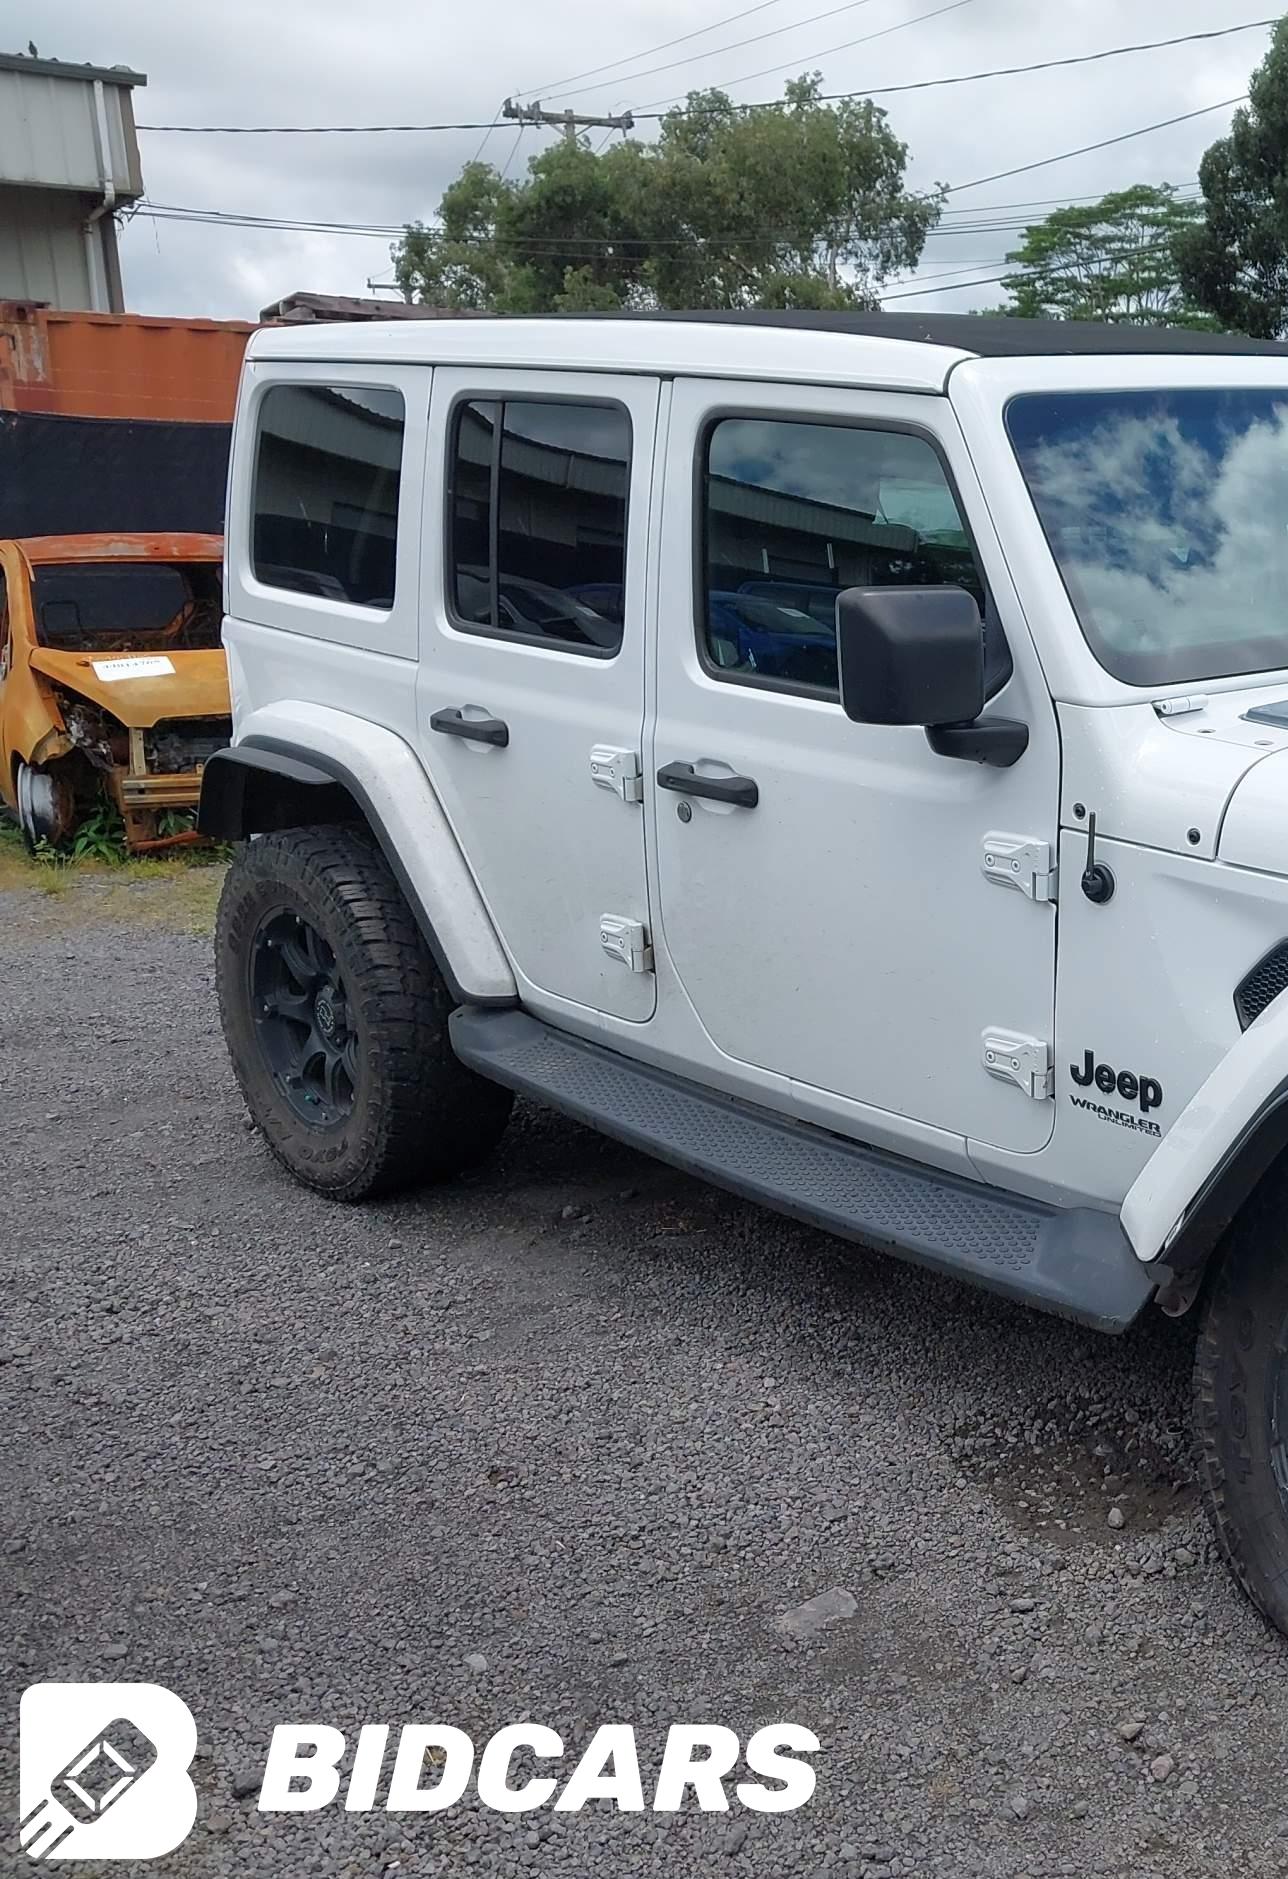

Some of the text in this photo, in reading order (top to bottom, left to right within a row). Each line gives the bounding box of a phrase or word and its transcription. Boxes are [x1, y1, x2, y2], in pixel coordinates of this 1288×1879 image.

[1069, 1049, 1163, 1113] Jeep
[1068, 1094, 1161, 1133] WRANGLER
[1097, 1112, 1162, 1138] UNLIMITED
